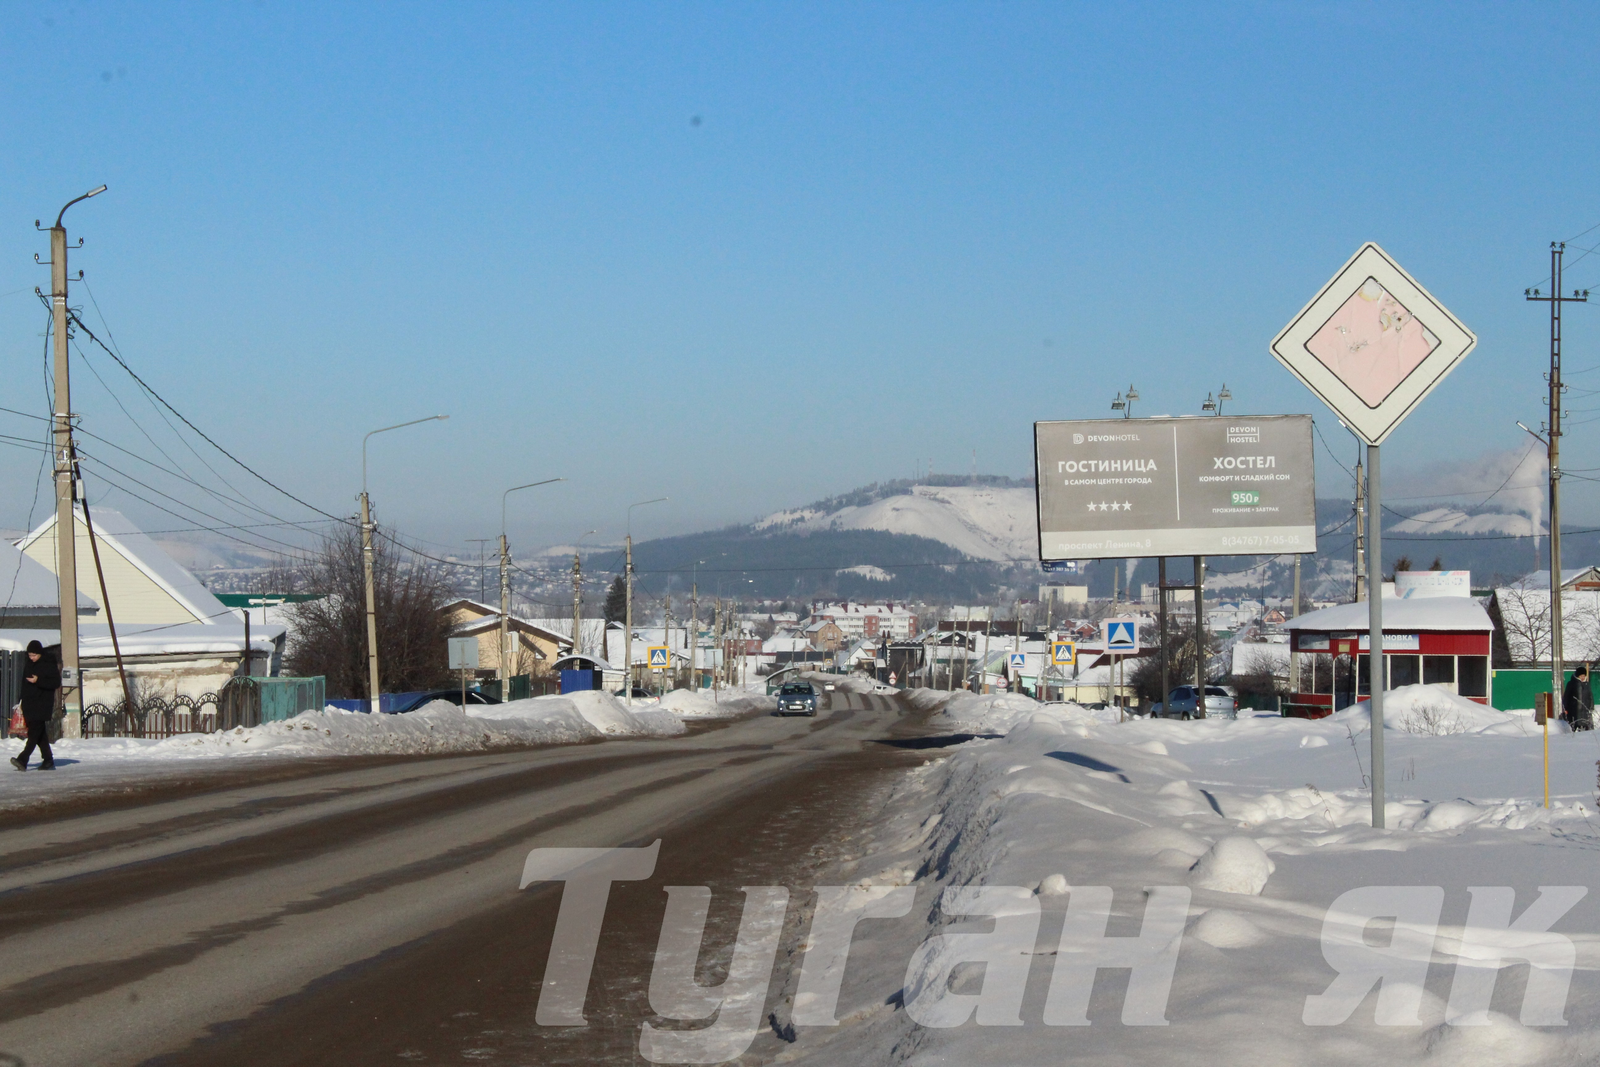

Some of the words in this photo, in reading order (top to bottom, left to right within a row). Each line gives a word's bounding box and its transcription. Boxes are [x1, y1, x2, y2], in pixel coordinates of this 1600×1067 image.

[1058, 459, 1158, 473] ГОСТИНИЦА
[1213, 456, 1276, 469] ХОСТЕЛ
[1097, 478, 1123, 486] ЦЕНТРЕ
[1241, 473, 1275, 481] СЛАДКИЙ
[1264, 535, 1300, 545] 7-05-05
[1058, 542, 1103, 551] проспект
[1105, 541, 1143, 549] Ленина,
[1145, 540, 1152, 548] 8
